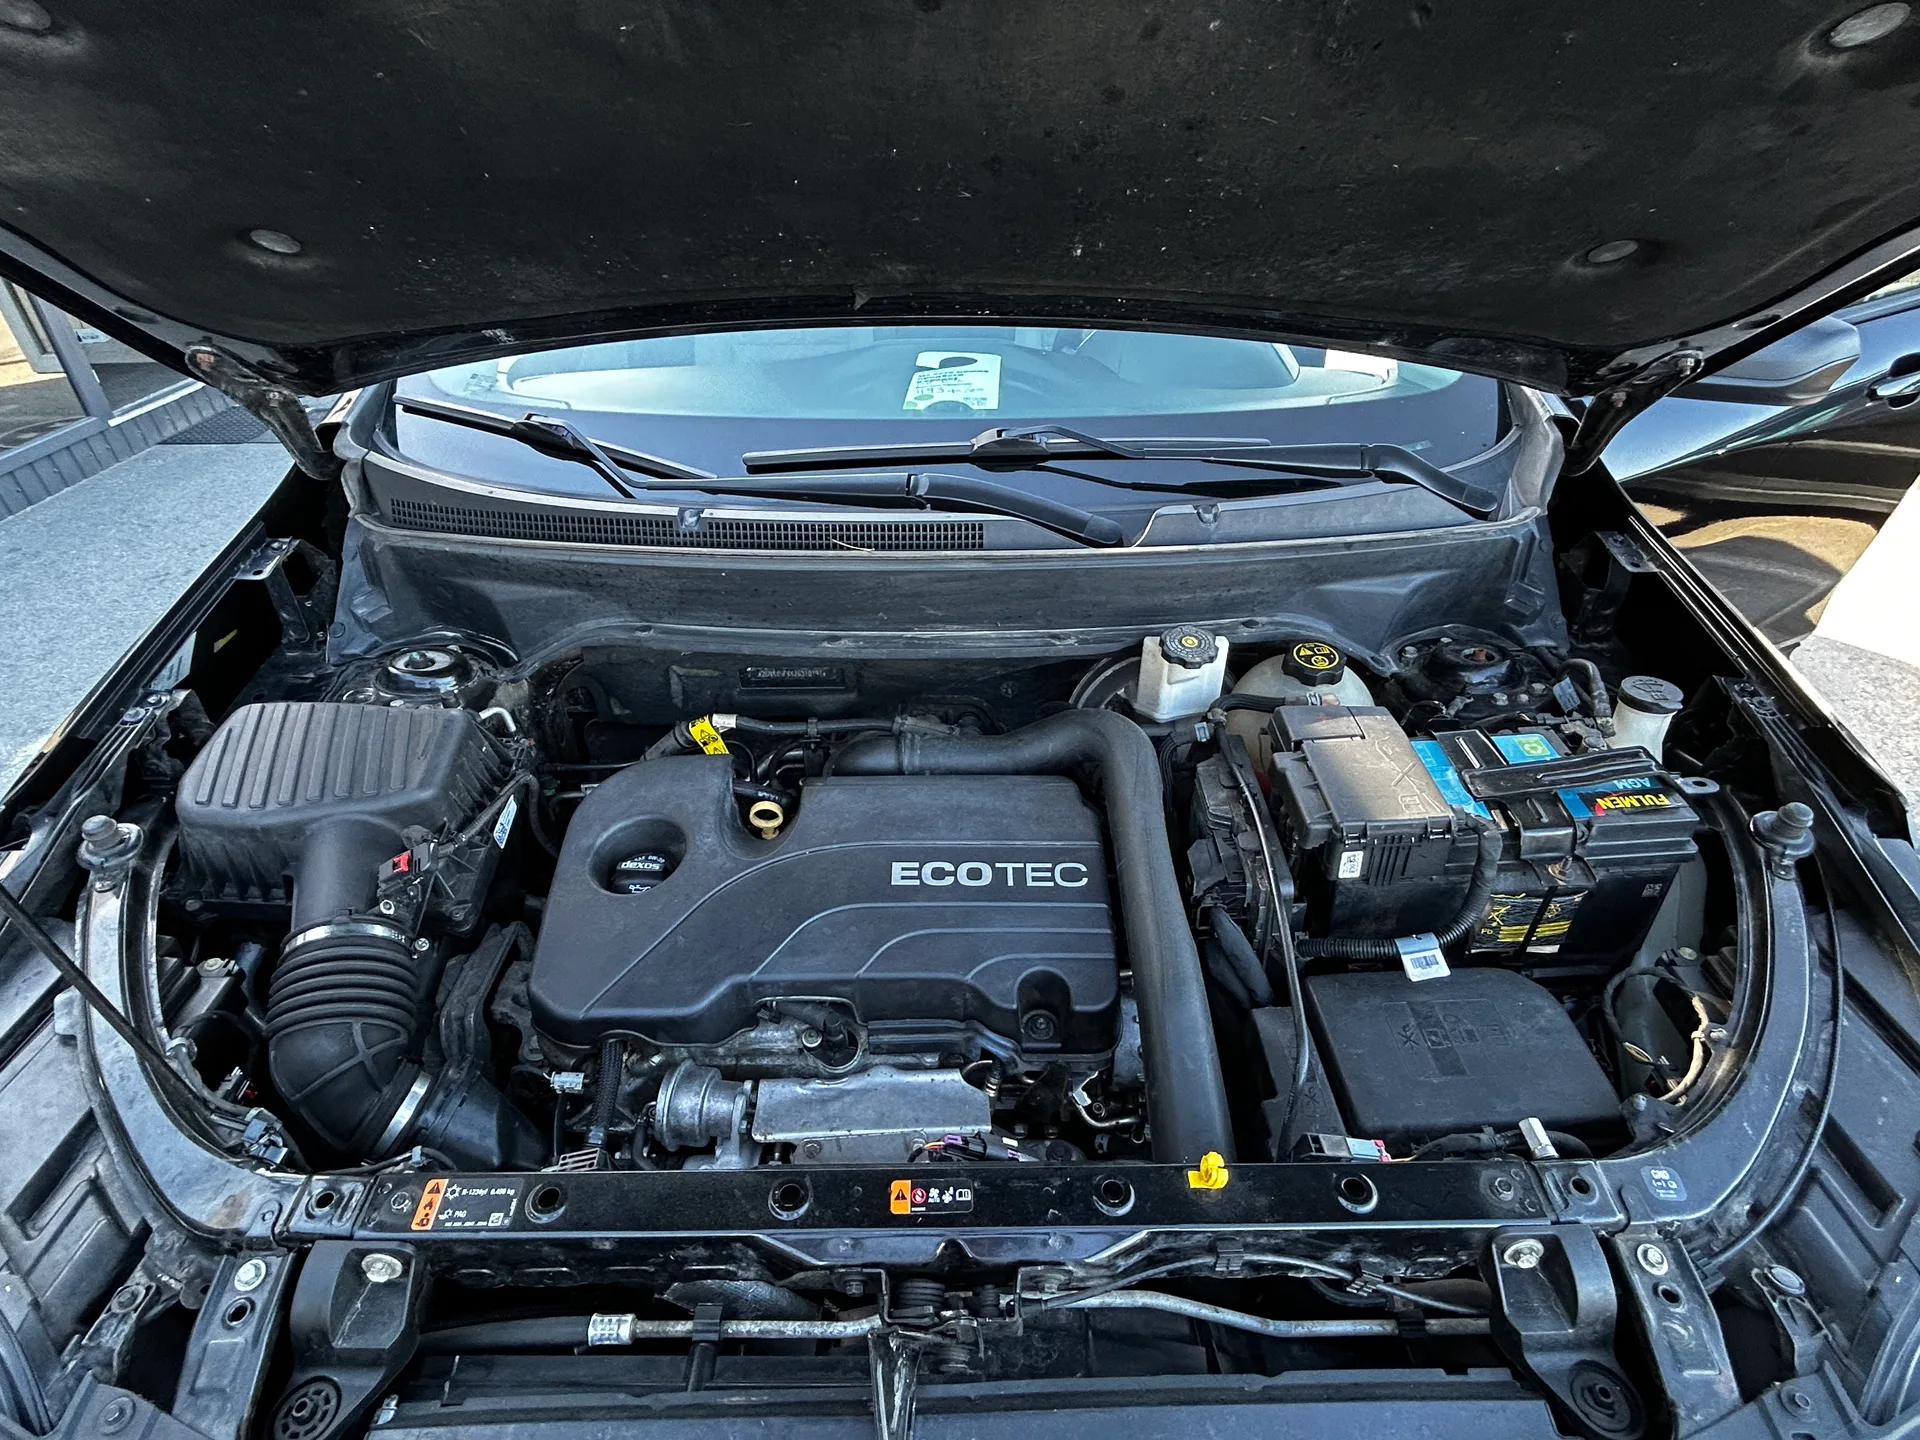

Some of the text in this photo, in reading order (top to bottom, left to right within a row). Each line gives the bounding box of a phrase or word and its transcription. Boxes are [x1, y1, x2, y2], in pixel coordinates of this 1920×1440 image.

[1612, 777, 1651, 790] AGM
[1595, 793, 1672, 810] FULMEN
[621, 860, 660, 870] dexos
[890, 861, 1089, 888] ECOTEC
[453, 1210, 468, 1218] PAG
